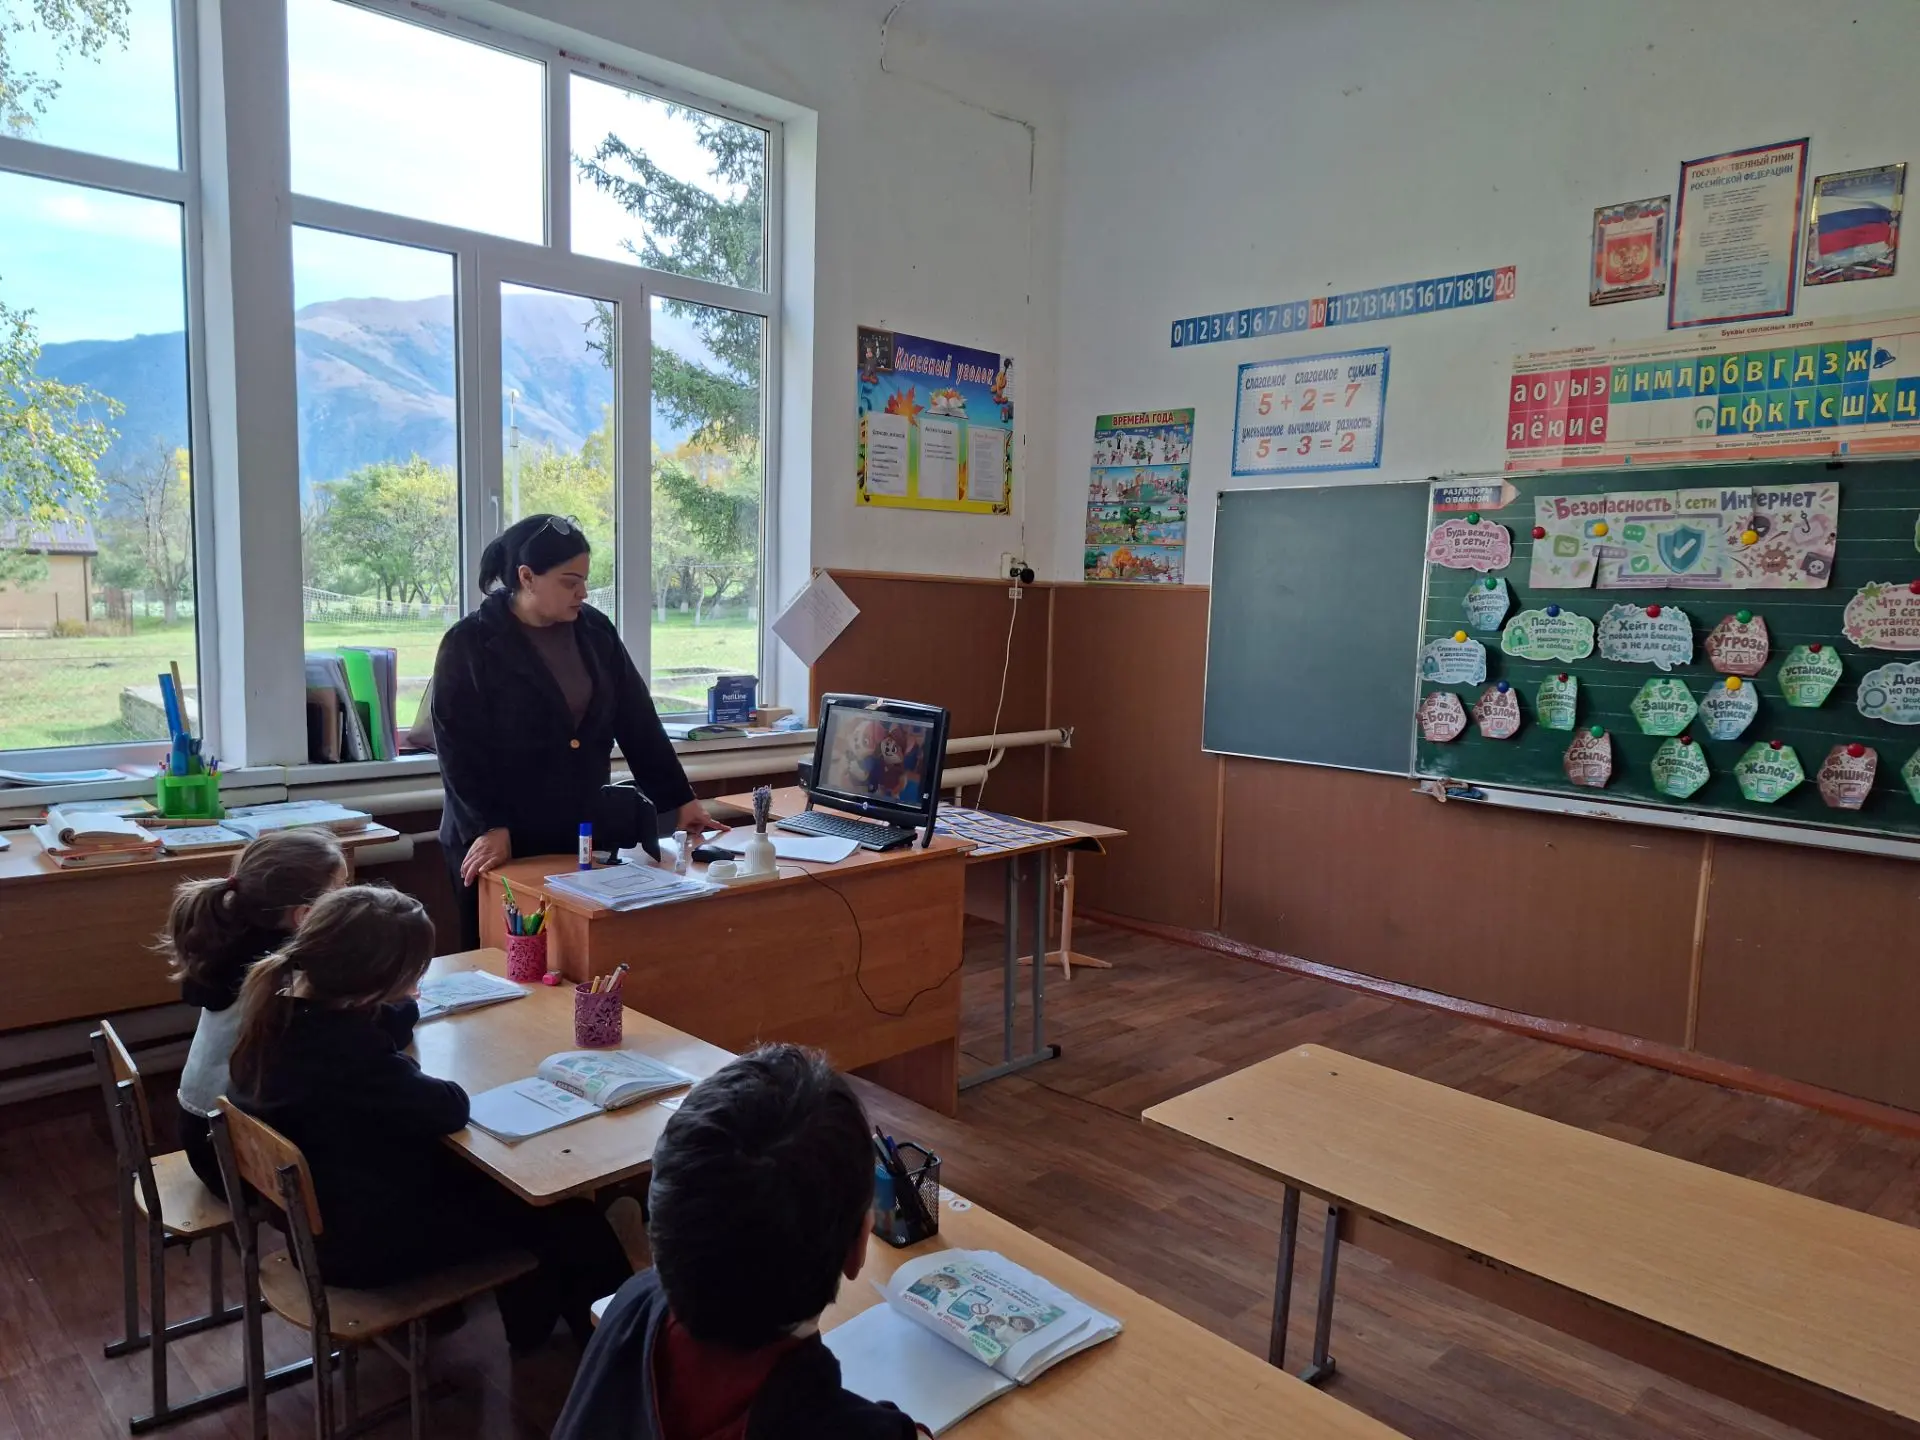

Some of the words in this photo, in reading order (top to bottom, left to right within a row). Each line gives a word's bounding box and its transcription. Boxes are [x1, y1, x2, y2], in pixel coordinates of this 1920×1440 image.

[1771, 152, 1794, 165] ГИМН
[1690, 172, 1742, 191] РОССИЙСКОЙ
[1743, 165, 1793, 181] ФЕДЕРАЦИИ
[1174, 325, 1182, 343] 0
[1188, 323, 1193, 341] 1
[1200, 321, 1208, 339] 2
[1212, 319, 1220, 338] 3
[1225, 317, 1235, 335] 4
[1240, 314, 1248, 334] 5
[1253, 312, 1262, 331] 6
[1268, 311, 1277, 330] 7
[1282, 308, 1291, 328] 8
[1297, 306, 1306, 325] 9
[1312, 303, 1324, 324] 10
[1329, 301, 1341, 321] 11
[1346, 298, 1358, 318] 12
[1363, 296, 1376, 315] 13
[1381, 292, 1396, 312] 14
[1399, 288, 1413, 310] 15
[1417, 285, 1433, 307] 16
[1437, 282, 1454, 304] 17
[1457, 279, 1473, 301] 18
[1477, 276, 1494, 298] 19
[1496, 272, 1513, 295] 20
[1721, 327, 1745, 337] Буквы
[1747, 323, 1786, 334] согласных
[1788, 319, 1814, 329] звуков
[894, 346, 953, 378] Классный
[1245, 374, 1286, 391] слагаемое
[1295, 368, 1338, 384] слагаемое
[1348, 363, 1377, 382] сумма
[1514, 384, 1527, 402] а
[1533, 382, 1547, 400] о
[1553, 380, 1565, 405] у
[1571, 378, 1588, 397] ы
[1594, 377, 1606, 395] э
[1614, 368, 1628, 393] й
[1635, 372, 1649, 391] н
[1654, 370, 1673, 389] м
[1677, 368, 1692, 387] л
[1699, 365, 1716, 392] р
[1722, 356, 1739, 384] б
[1747, 361, 1763, 381] в
[1774, 358, 1786, 379] г
[1794, 356, 1814, 382] д
[1823, 352, 1838, 374] з
[1847, 350, 1868, 371] ж
[1258, 392, 1273, 416] 5
[1300, 388, 1317, 412] 2
[1344, 383, 1362, 408] 7
[1112, 414, 1150, 426] ВРЕМЕНА
[1152, 412, 1174, 424] ГОДА
[1511, 422, 1525, 440] я
[1531, 415, 1544, 439] ё
[1548, 419, 1564, 437] ю
[1569, 417, 1583, 436] и
[1591, 416, 1604, 434] е
[1720, 406, 1736, 426] п
[1742, 398, 1763, 431] ф
[1768, 402, 1784, 422] к
[1794, 400, 1809, 420] т
[1820, 397, 1834, 418] с
[1842, 394, 1864, 417] ш
[1871, 392, 1889, 414] х
[1897, 390, 1916, 417] ц
[1288, 420, 1331, 435] вычитаемое
[1256, 439, 1271, 458] 5
[1297, 435, 1313, 455] 3
[1338, 432, 1356, 453] 2
[1443, 487, 1493, 496] РАЗГОВОРЫ
[1453, 495, 1489, 503] ВАЖНОМ
[1554, 497, 1672, 520] Безопасность
[1685, 498, 1717, 510] сети
[1720, 490, 1816, 511] Интернет
[1446, 527, 1466, 539] Будь
[1468, 529, 1499, 539] вежлив
[1463, 538, 1490, 547] сети!
[1876, 597, 1901, 608] Что
[1889, 608, 1896, 617] в
[1532, 617, 1566, 627] Пароль
[1619, 620, 1648, 632] Хейт
[1658, 622, 1678, 631] сети
[1880, 627, 1920, 638] навсе
[1713, 634, 1767, 651] Угрозы
[1905, 687, 1920, 696] пр
[1483, 705, 1516, 719] Взлом
[1641, 699, 1689, 713] Защита
[1428, 709, 1458, 724] Боты
[1713, 710, 1747, 720] список
[1569, 749, 1611, 763] Ссылки
[1657, 757, 1704, 775] Сложный
[1744, 763, 1796, 782] Жалоба
